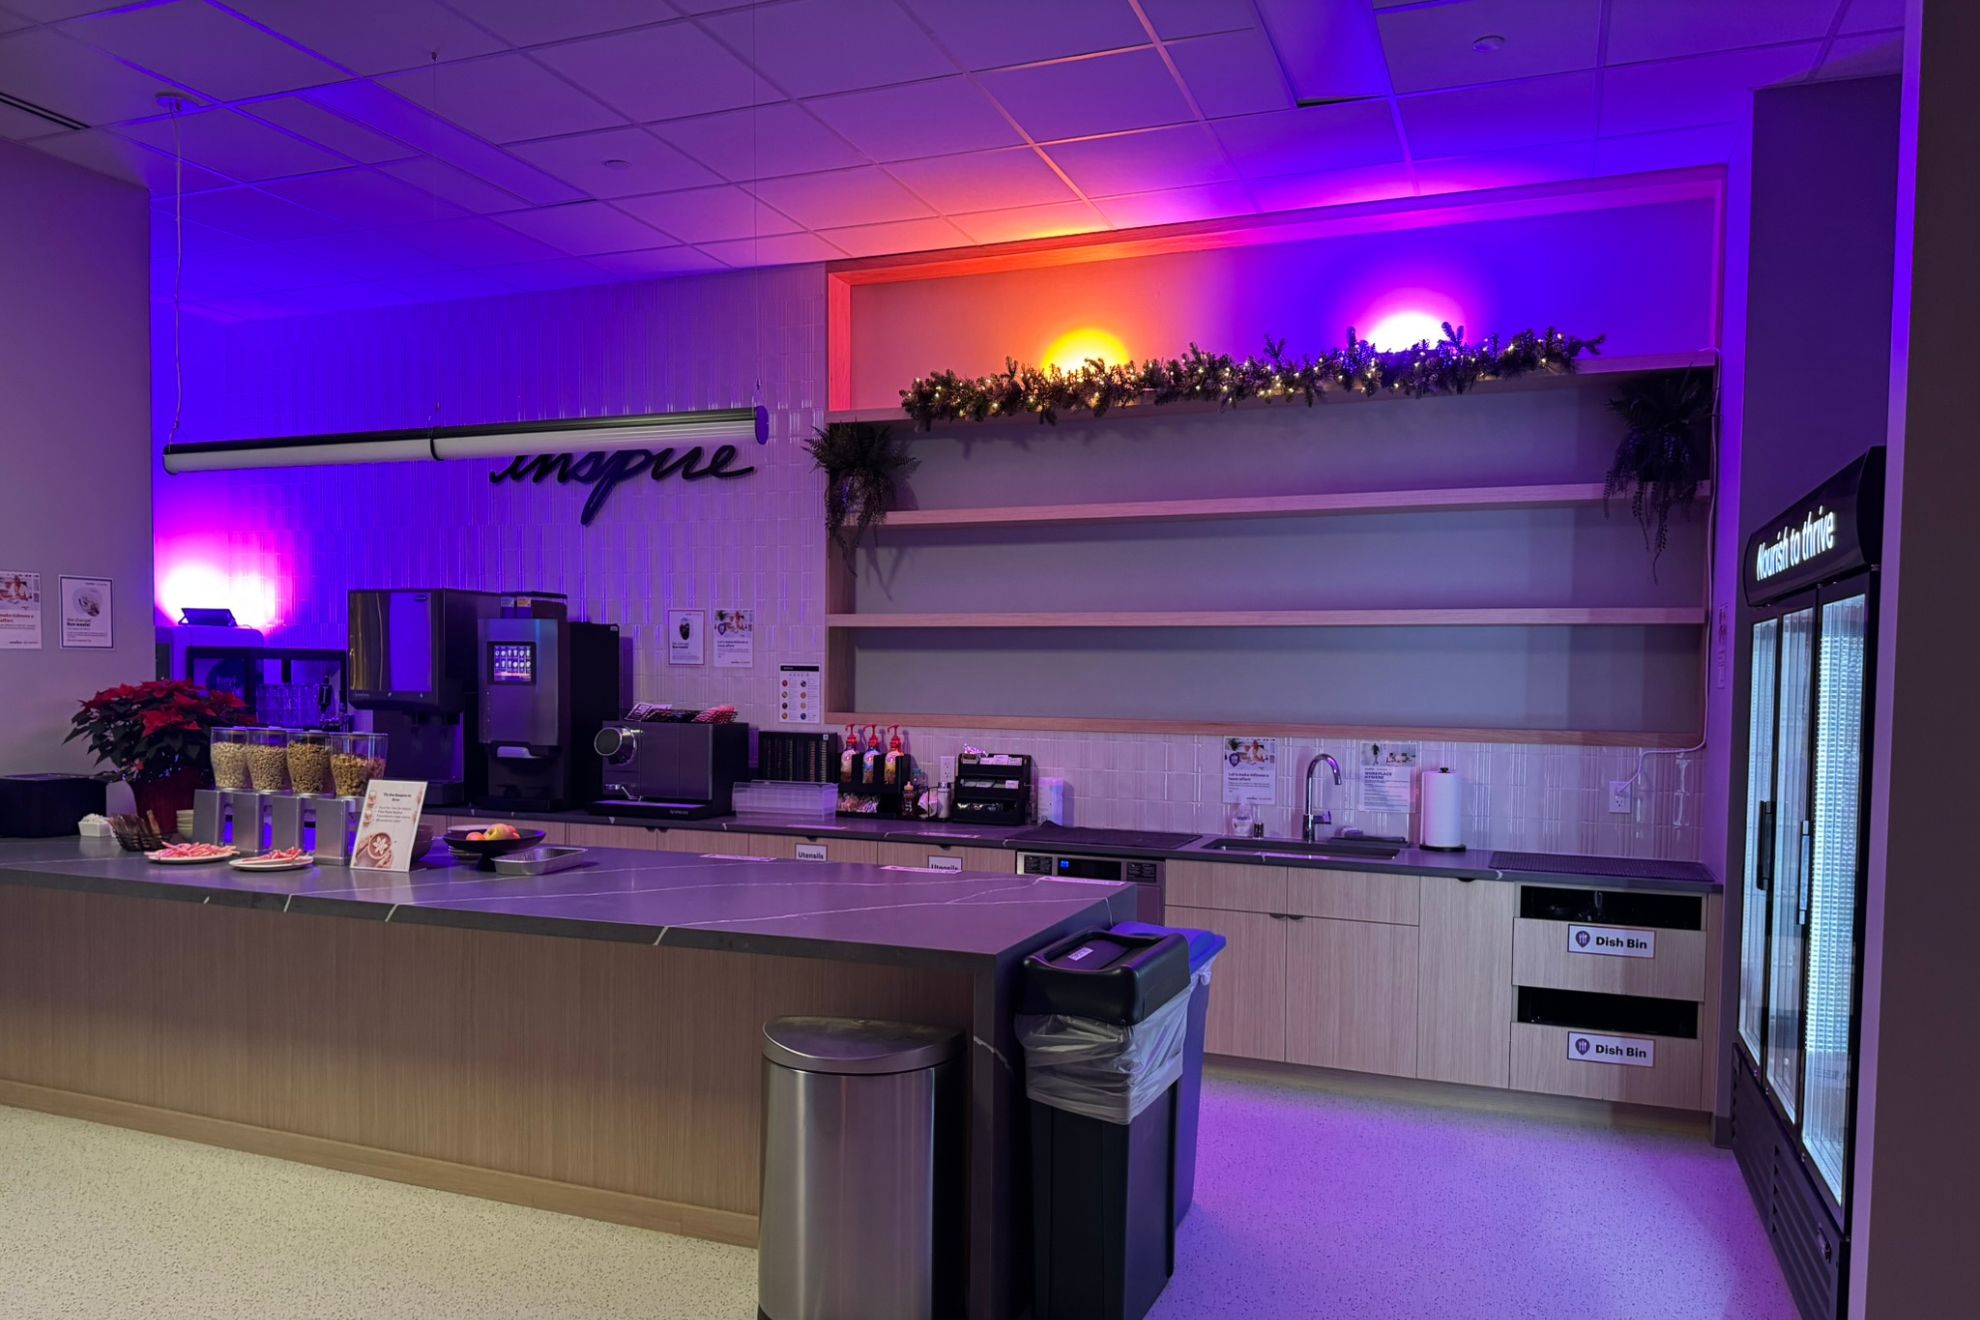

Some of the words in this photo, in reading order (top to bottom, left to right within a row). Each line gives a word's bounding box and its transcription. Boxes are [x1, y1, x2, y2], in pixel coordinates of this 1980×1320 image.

[489, 445, 755, 526] inspire
[1757, 526, 1789, 582] Nourish
[1790, 528, 1801, 567] to
[1802, 505, 1834, 561] thrive
[798, 851, 824, 859] Utensils
[1596, 936, 1624, 948] Dish
[1627, 938, 1648, 949] Bin
[1595, 1044, 1623, 1056] Dish
[1626, 1047, 1647, 1058] Bin
